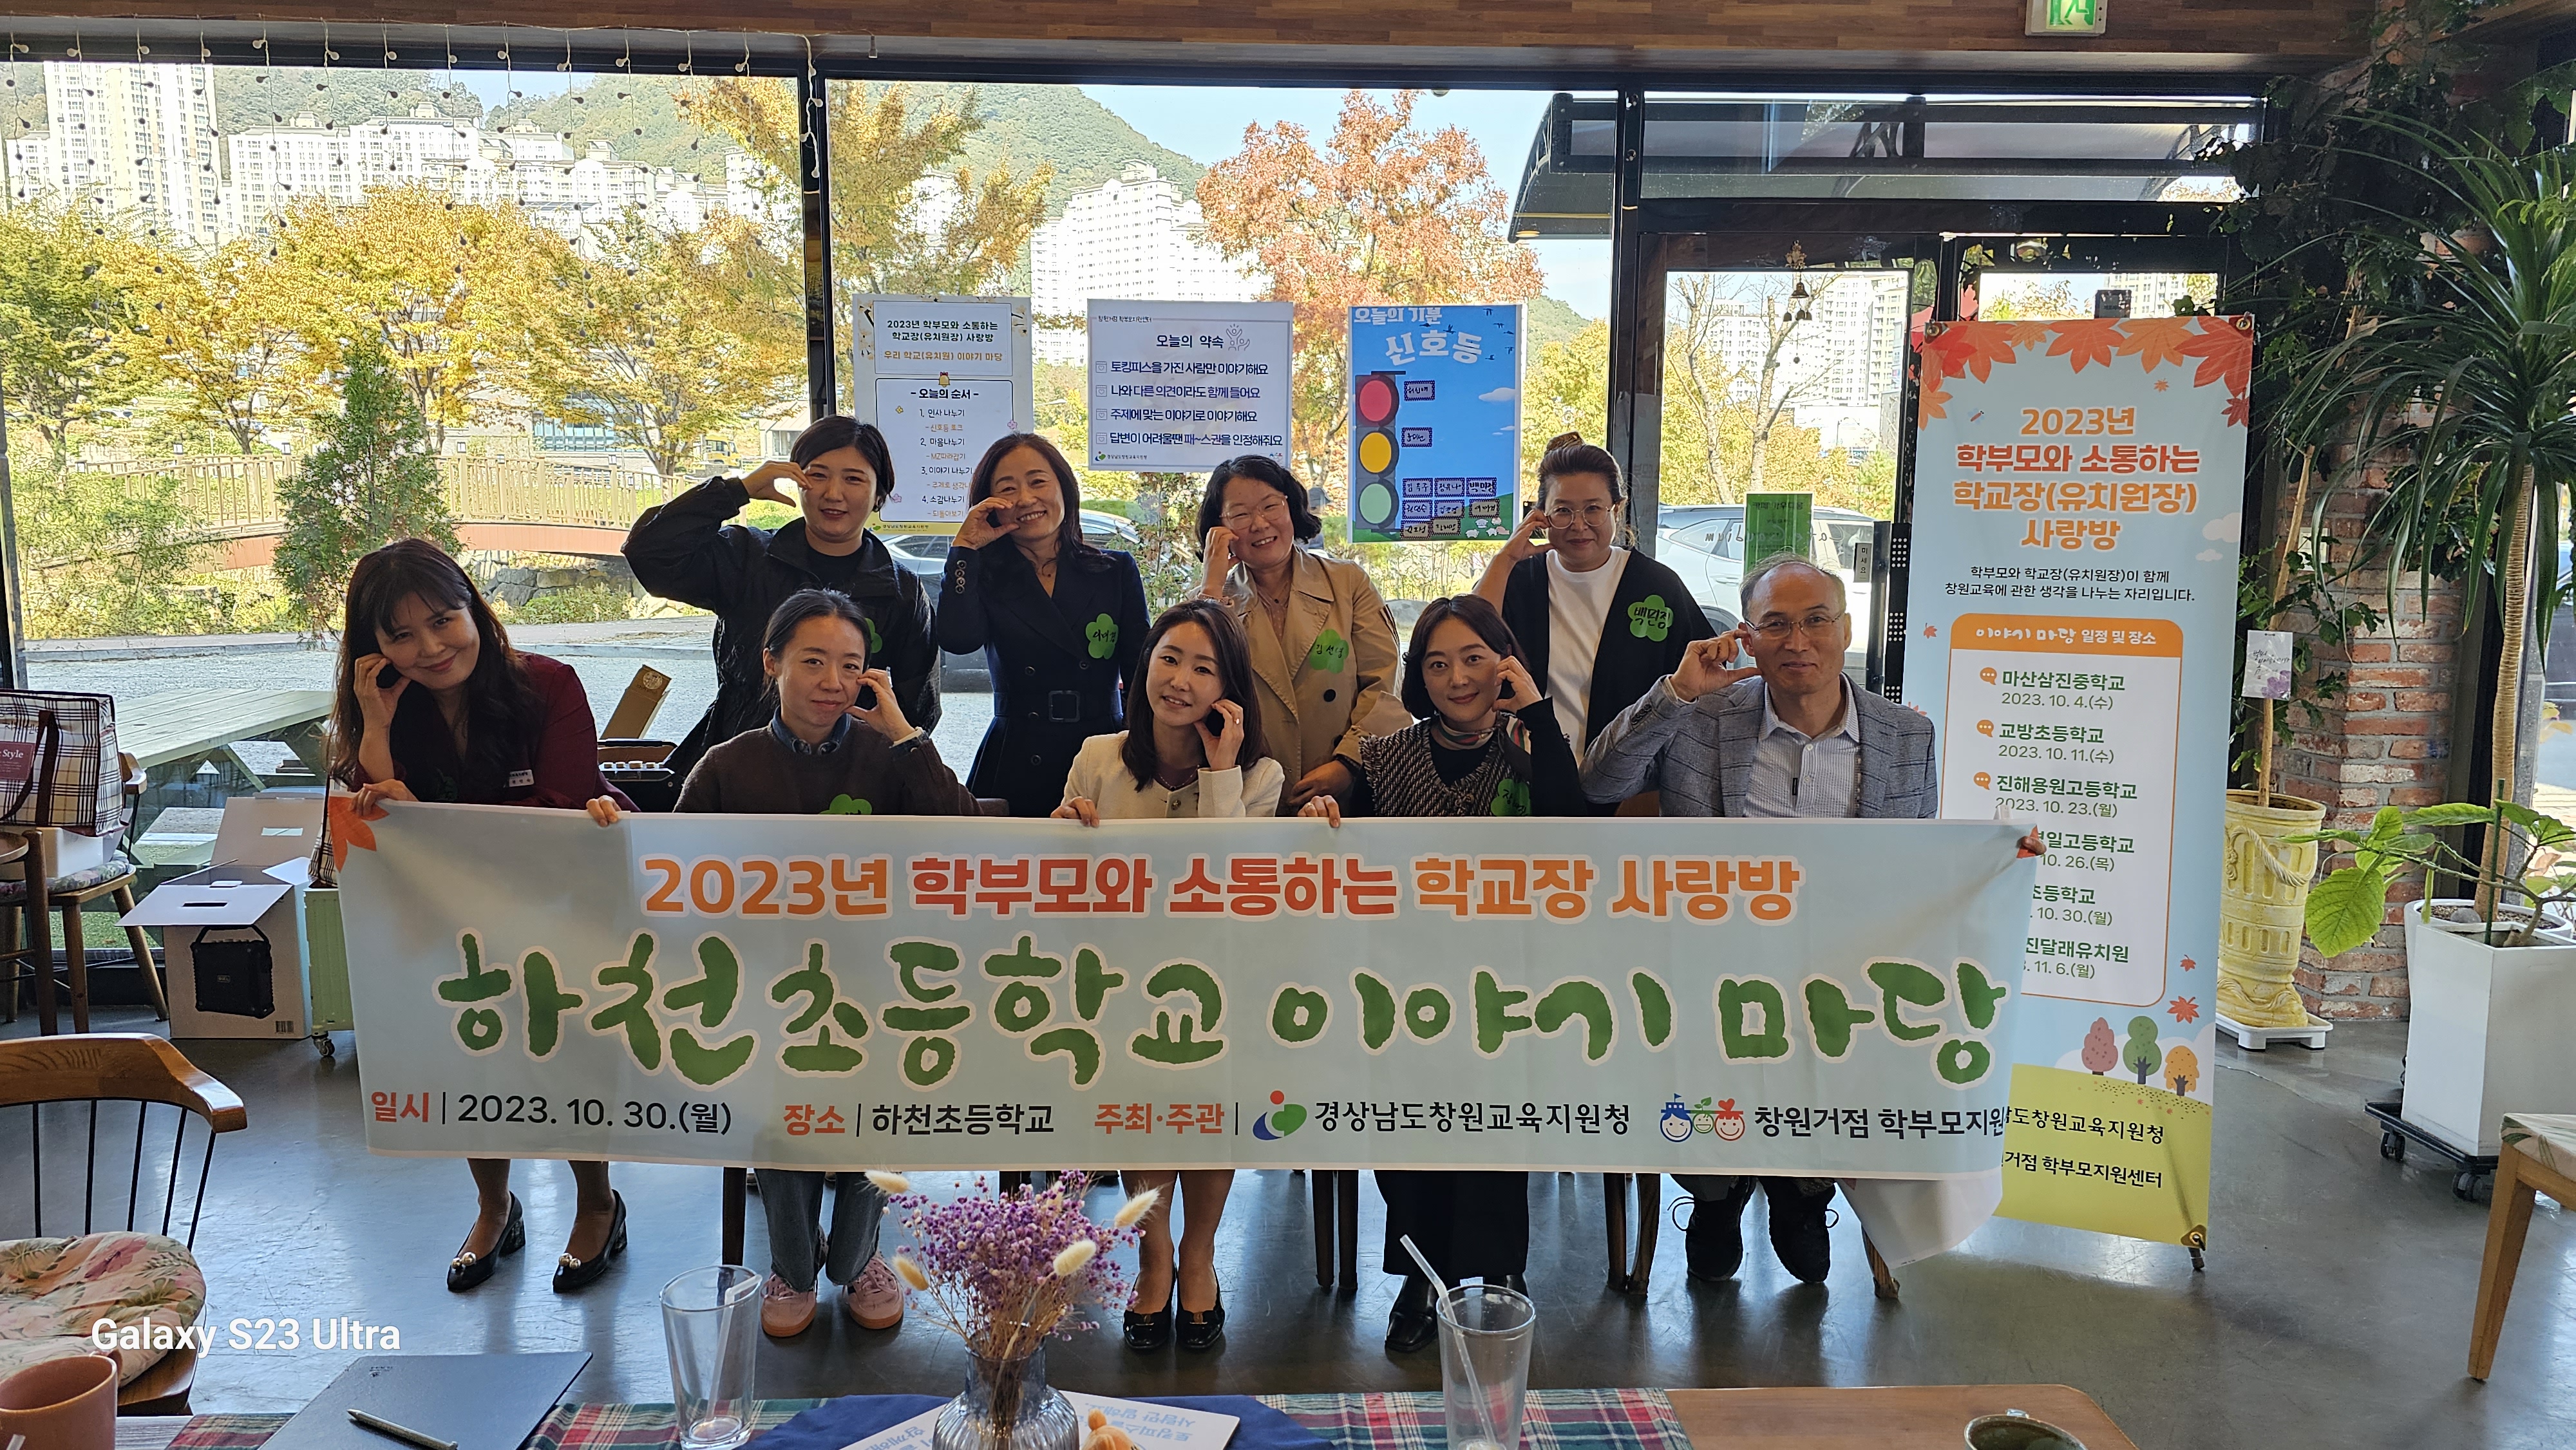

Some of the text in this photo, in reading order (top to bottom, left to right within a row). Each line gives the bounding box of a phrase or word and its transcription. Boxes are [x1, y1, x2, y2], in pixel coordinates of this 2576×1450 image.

[887, 320, 998, 330] 2023년 학부모와 소통하는
[1354, 307, 1442, 325] 오늘의 기분
[892, 332, 994, 343] 학교장(유치원장) 사랑방
[1157, 335, 1224, 349] 오늘의 약속
[884, 351, 1003, 361] 우리 학교(유치원) 이야기 마당
[1385, 330, 1482, 366] 신호등
[1110, 361, 1269, 375] 토킹피스을 가진 사람만 이야기해요
[918, 389, 971, 400] 오늘의 순서
[1111, 385, 1260, 399] 나와 다른 의견이라도 함께 들어요
[927, 408, 942, 418] 인사
[943, 409, 965, 418] 나누기
[1110, 409, 1257, 422] 주제에 맞는 이야기로 이야기해요
[2020, 408, 2136, 436] 2023년
[930, 438, 965, 447] 마음나누기
[1110, 433, 1141, 444] 답변이
[1142, 433, 1183, 445] 어려울땐
[1184, 434, 1231, 446] 패~스권을
[931, 453, 965, 461] MZ따라잡기
[1956, 444, 2200, 474] 학부모와 소통하는
[952, 467, 972, 475] 나누기
[930, 496, 965, 504] 소감나누기
[1953, 481, 2197, 514] 학교장(유치원장)
[2021, 520, 2121, 550] 사랑방
[1970, 566, 2170, 583] 학부모와 학교장(유치원장)이 함께
[1945, 583, 2196, 602] 창원교육에 관한 생각을 나누는 자리입니다.
[1975, 626, 2157, 645] 이야기 마당 일정 및 장소
[2002, 670, 2125, 692] 마산삼진중학교
[2001, 692, 2114, 711] 2023. 10. 4.(수)
[1999, 722, 2104, 744] 교방초등학교
[3, 749, 24, 760] Style
[1998, 745, 2114, 764] 2023. 10. 11.(수)
[1996, 775, 2137, 800] 진해용원고등학교
[2043, 801, 2063, 813] 10.
[2068, 802, 2117, 818] 23.(월)
[2040, 854, 2115, 872] 10. 26.(목)
[644, 857, 1801, 921] 2023년 학부모와 소통하는 학교장 사랑방
[2037, 907, 2112, 926] 10. 30.(월)
[2034, 961, 2051, 974] 11.
[2056, 963, 2095, 979] 6.(월)
[437, 931, 2007, 1086] 하천초등학교 이야기 마당
[370, 1091, 430, 1123] 일시
[457, 1093, 558, 1124] 2023.
[567, 1098, 614, 1127] 10.
[623, 1101, 733, 1136] 30.(월)
[783, 1103, 845, 1136] 장소
[871, 1102, 1055, 1136] 하천초등학교
[1094, 1104, 1224, 1135] 주최·주관
[1314, 1100, 1631, 1136] 경상남도창원교육지원청
[1754, 1106, 1870, 1138] 창원거점
[2041, 1156, 2162, 1189] 학부모지원센터
